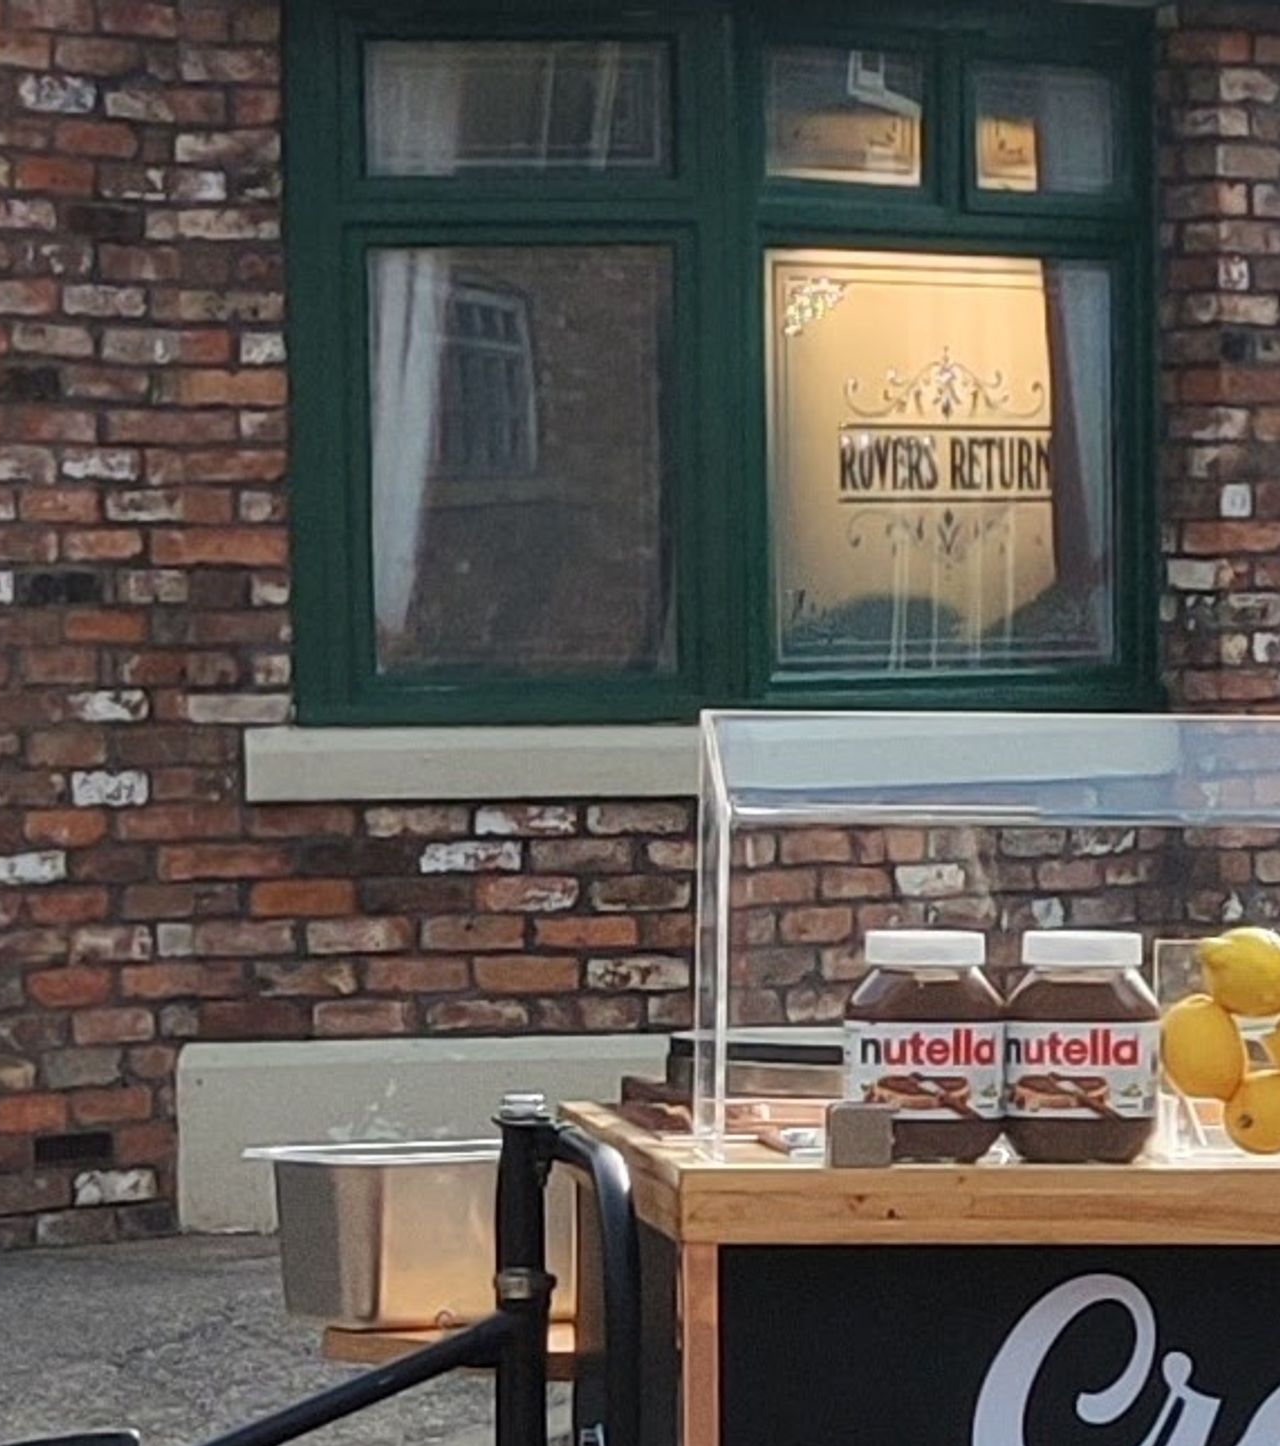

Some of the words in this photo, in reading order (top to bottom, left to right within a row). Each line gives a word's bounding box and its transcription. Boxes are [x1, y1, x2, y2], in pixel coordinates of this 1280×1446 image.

[839, 434, 939, 491] ROVERS
[949, 435, 1052, 491] RETURN
[860, 1028, 996, 1067] nutella
[1005, 1028, 1140, 1067] nutella
